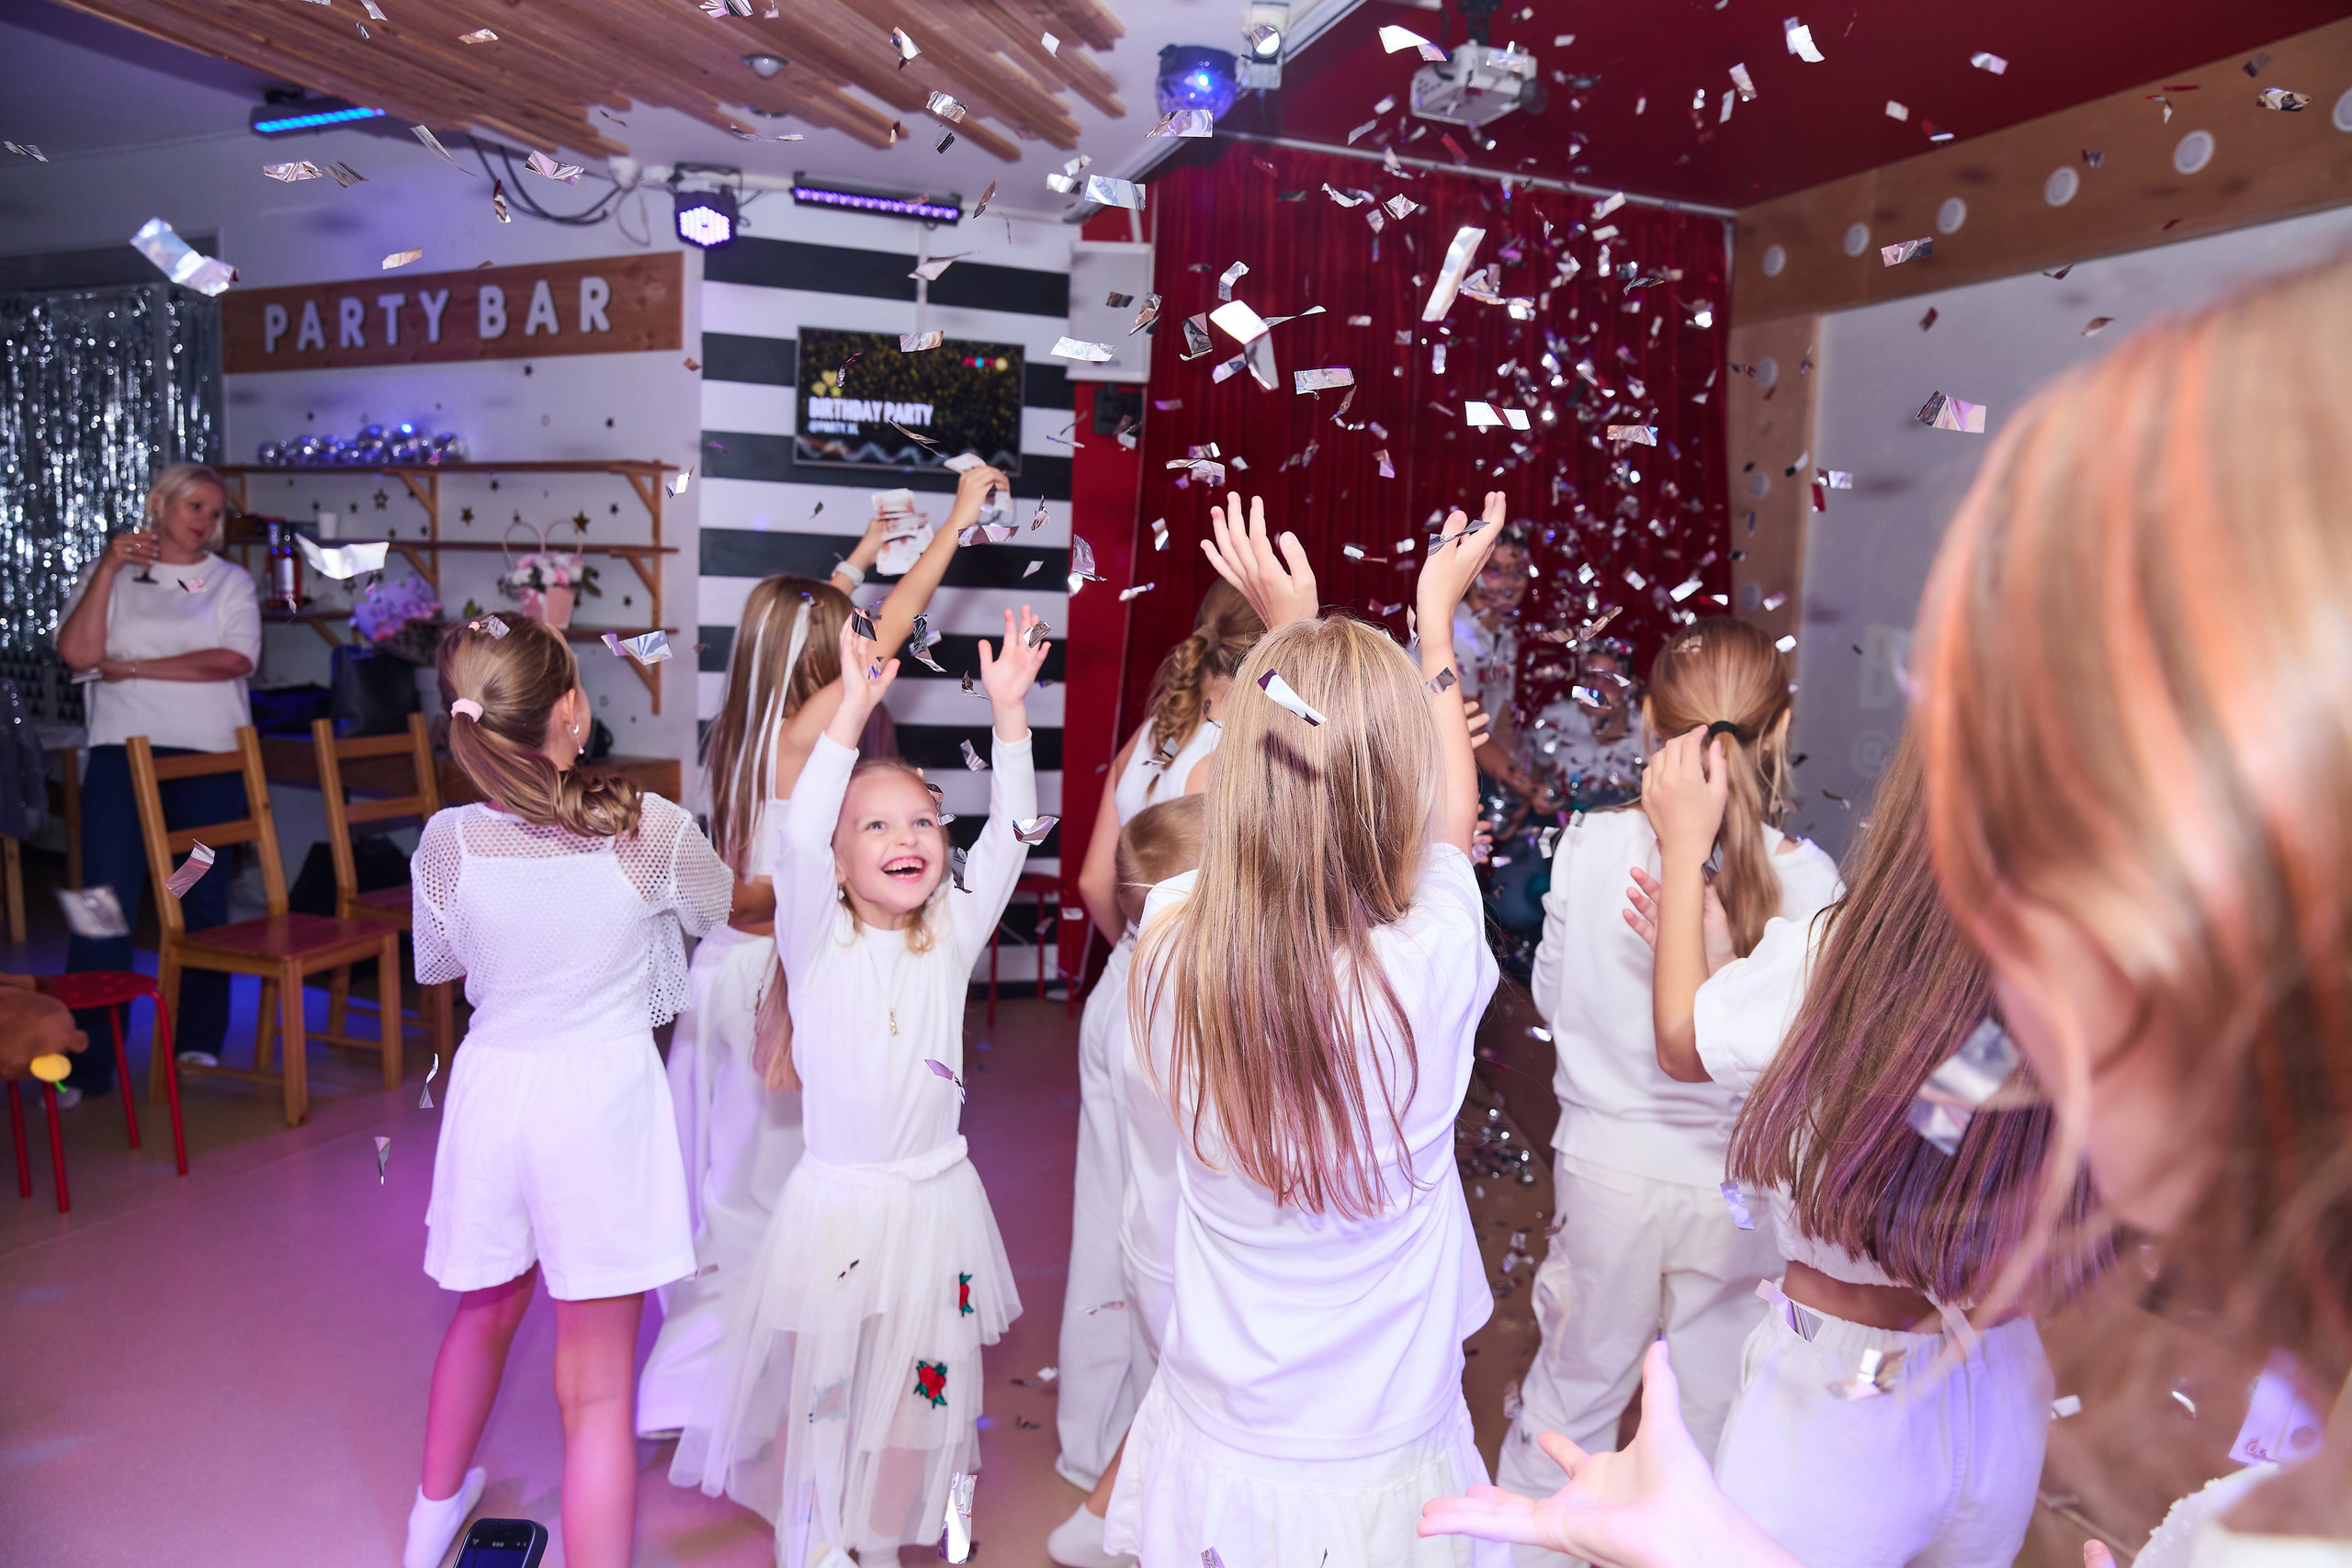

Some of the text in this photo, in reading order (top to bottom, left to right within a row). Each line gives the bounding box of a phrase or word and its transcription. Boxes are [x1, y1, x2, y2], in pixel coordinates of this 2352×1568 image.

[264, 276, 612, 354] PARTY BAR
[808, 396, 934, 426] BIRTHDAY PARTY
